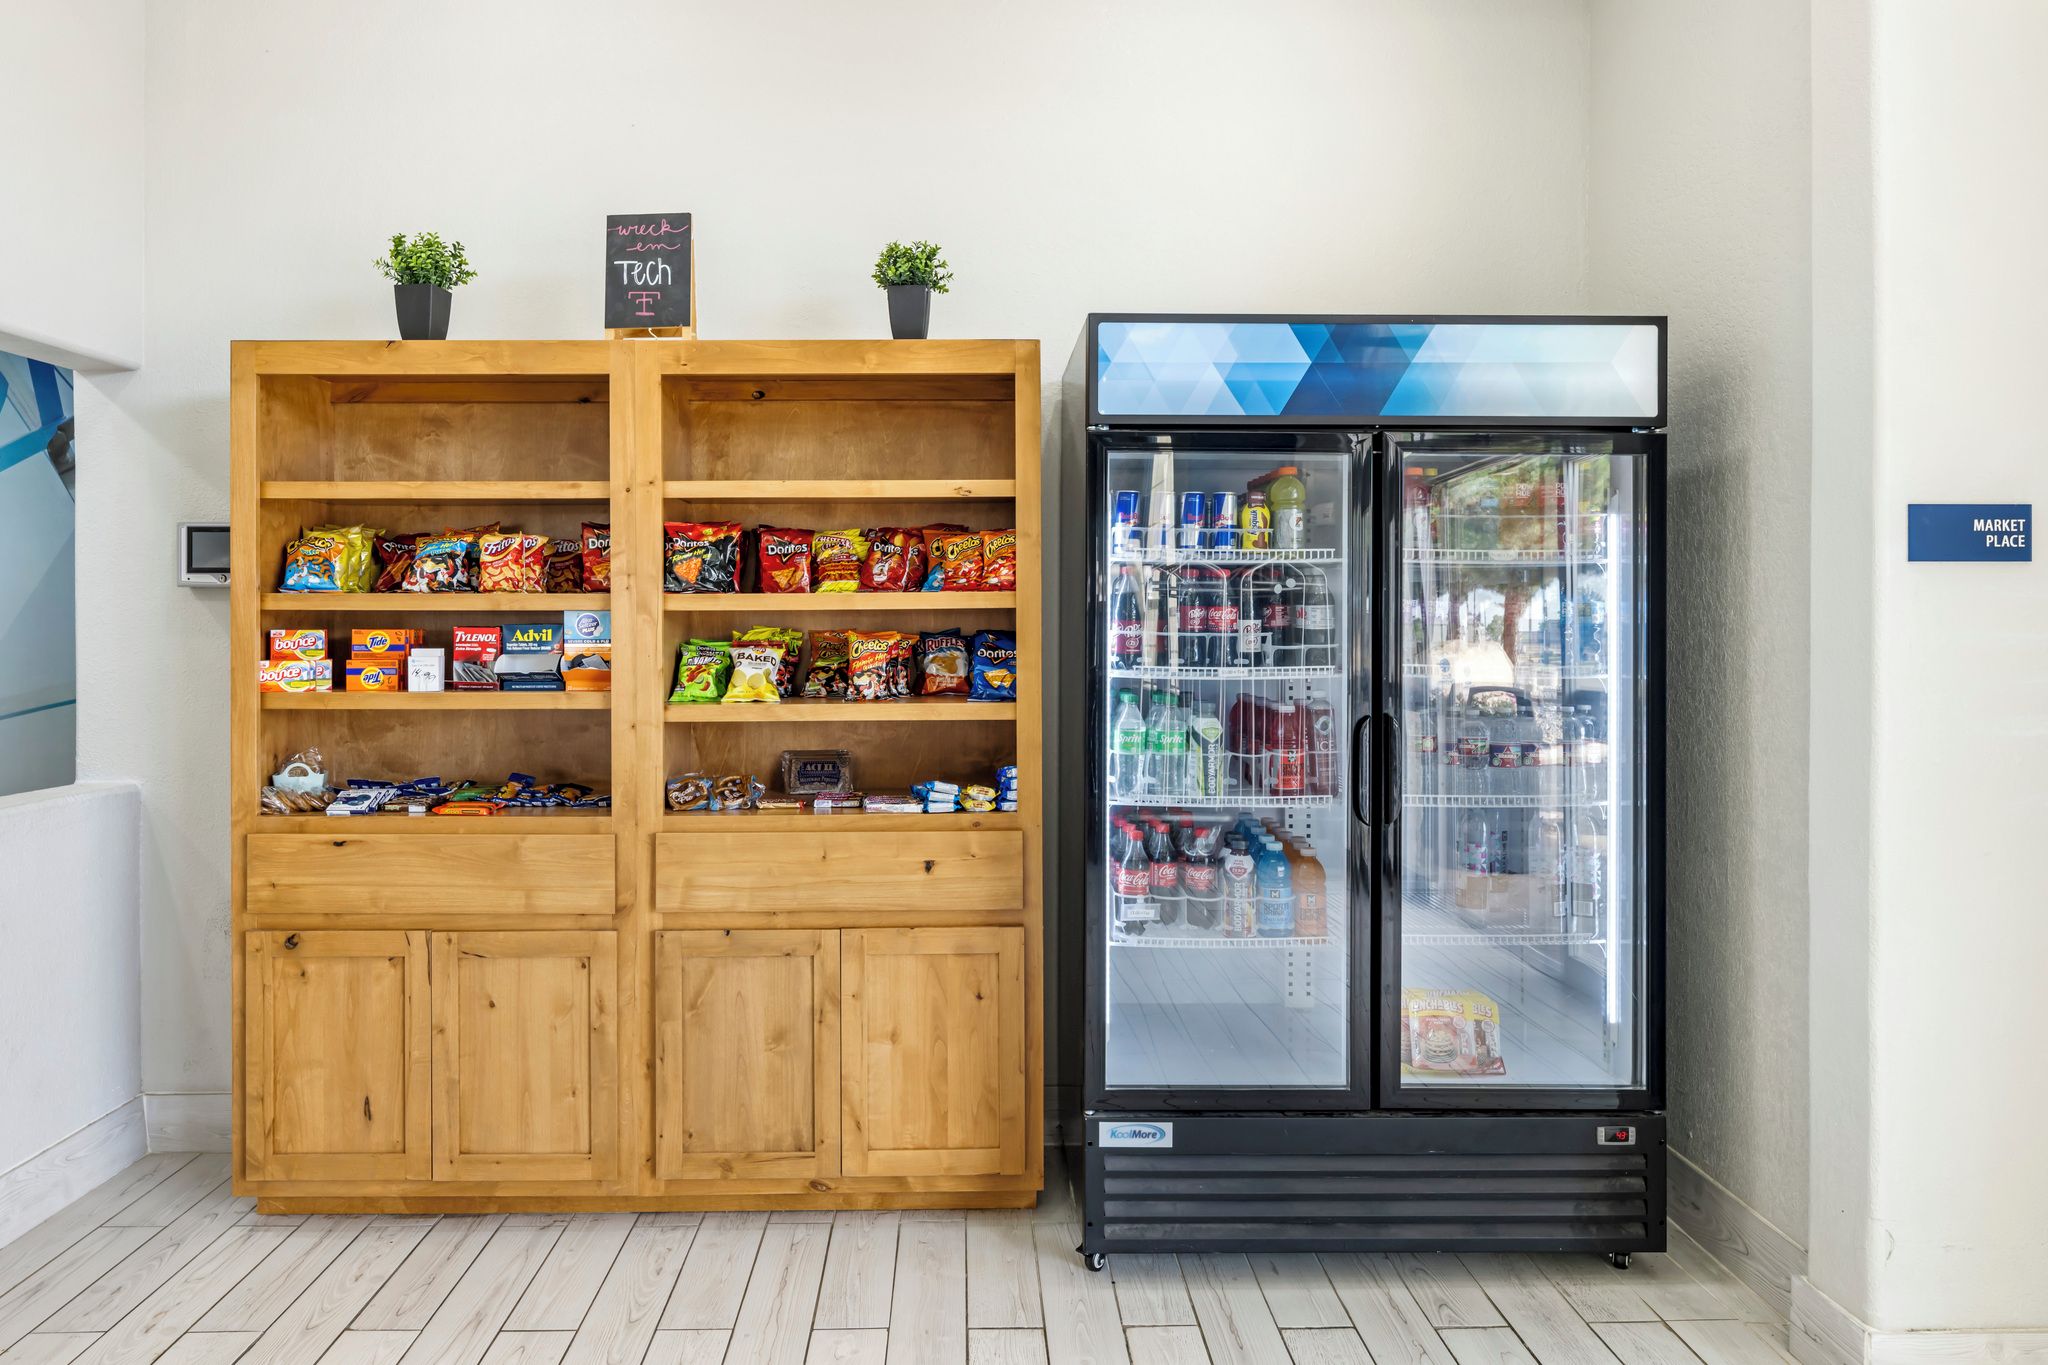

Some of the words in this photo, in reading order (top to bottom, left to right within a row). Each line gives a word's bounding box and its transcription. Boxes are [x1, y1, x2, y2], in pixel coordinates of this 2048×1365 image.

[614, 258, 671, 285] Tech
[1973, 519, 2025, 532] MARKET
[484, 538, 516, 555] Fritos
[673, 537, 710, 550] Doritos
[1986, 535, 2025, 547] PLACE
[767, 543, 808, 556] Doritos
[946, 536, 982, 560] Cheetos
[369, 636, 387, 648] Tide
[455, 630, 497, 642] TYLENOL
[511, 629, 553, 642] Advil
[275, 635, 316, 650] bounce
[851, 639, 890, 659] Cheetos
[925, 637, 966, 652] RUFFLES
[737, 652, 776, 667] BAKED
[977, 648, 1016, 659] Doritos
[259, 667, 301, 682] bounce
[1118, 733, 1142, 744] Sprite
[1159, 733, 1184, 744] Sprite
[1317, 740, 1334, 752] ICE
[1234, 882, 1242, 932] BODYARMOR
[1110, 1129, 1157, 1139] KoolMore
